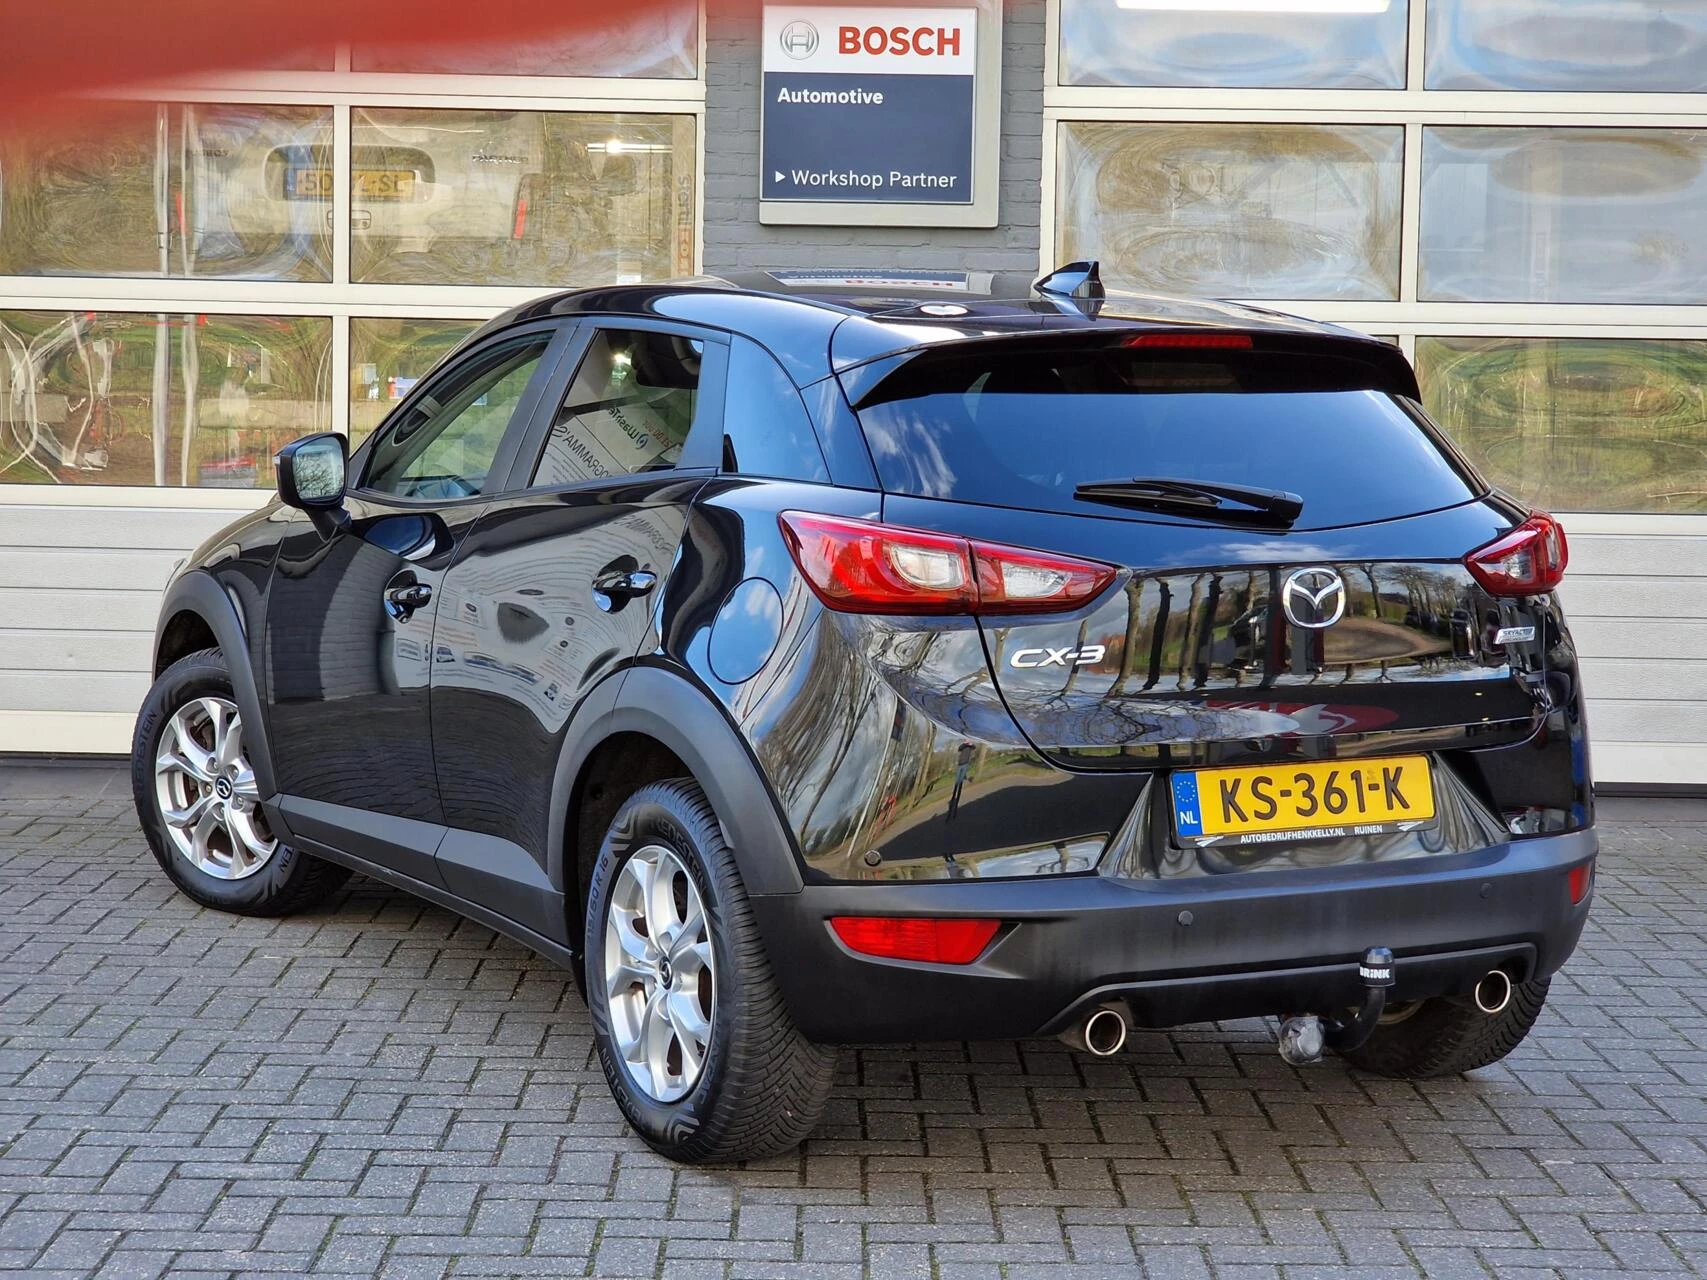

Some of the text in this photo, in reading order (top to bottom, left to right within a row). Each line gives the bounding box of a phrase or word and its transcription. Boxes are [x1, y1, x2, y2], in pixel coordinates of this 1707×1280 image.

[839, 26, 960, 56] BOSCH
[777, 88, 884, 105] Automotive
[792, 170, 957, 189] Workshop Partner
[1010, 645, 1105, 668] CX-3
[1219, 766, 1410, 823] KS-361-K
[1180, 811, 1198, 825] NL
[1354, 825, 1383, 835] RUINEN
